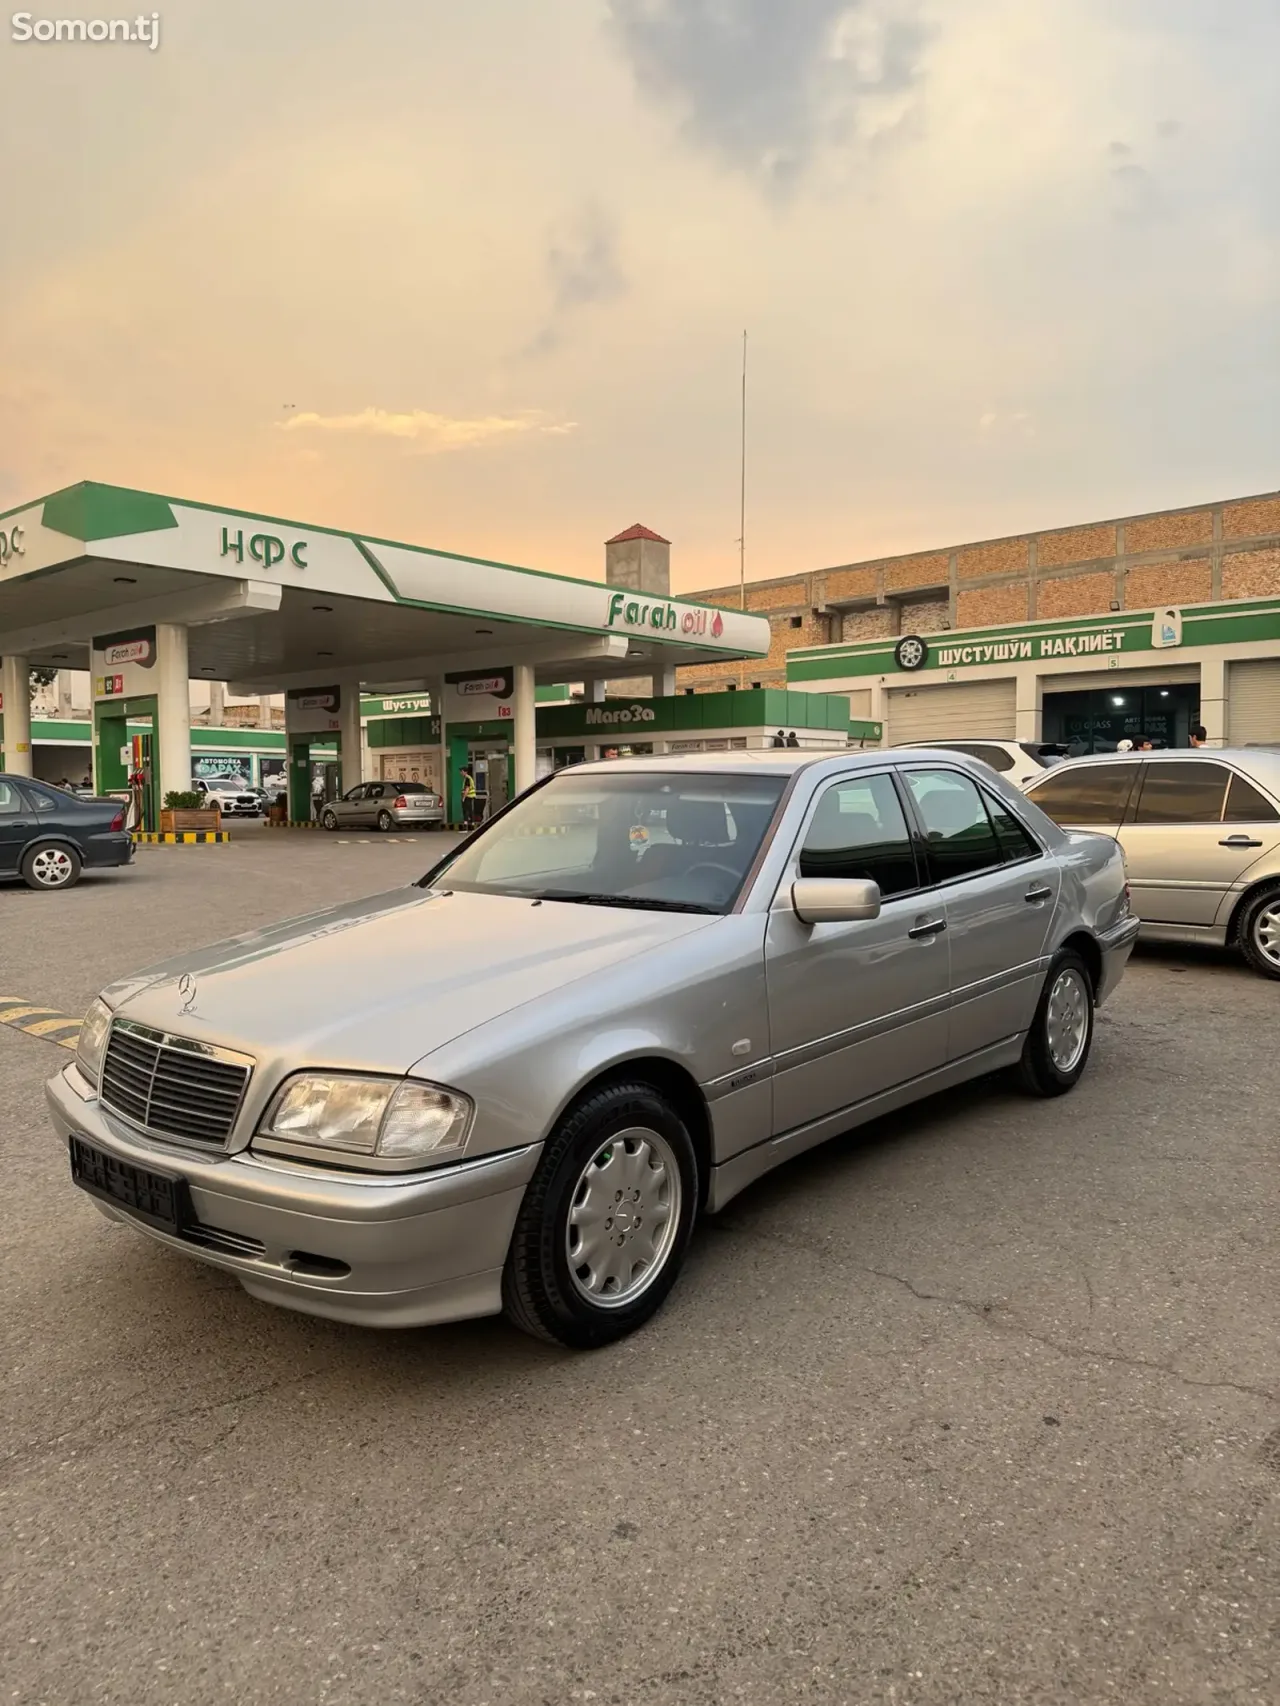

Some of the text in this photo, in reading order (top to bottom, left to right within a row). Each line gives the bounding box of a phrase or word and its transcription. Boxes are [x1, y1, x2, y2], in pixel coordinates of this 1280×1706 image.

[221, 527, 308, 569] НФС
[604, 593, 707, 635] Farah oil
[1041, 629, 1125, 656] НАҚЛИЁТ
[111, 648, 129, 662] Farah
[1110, 659, 1117, 668] 5
[383, 699, 431, 712] Шустуш
[200, 764, 242, 774] ФАРАХ
